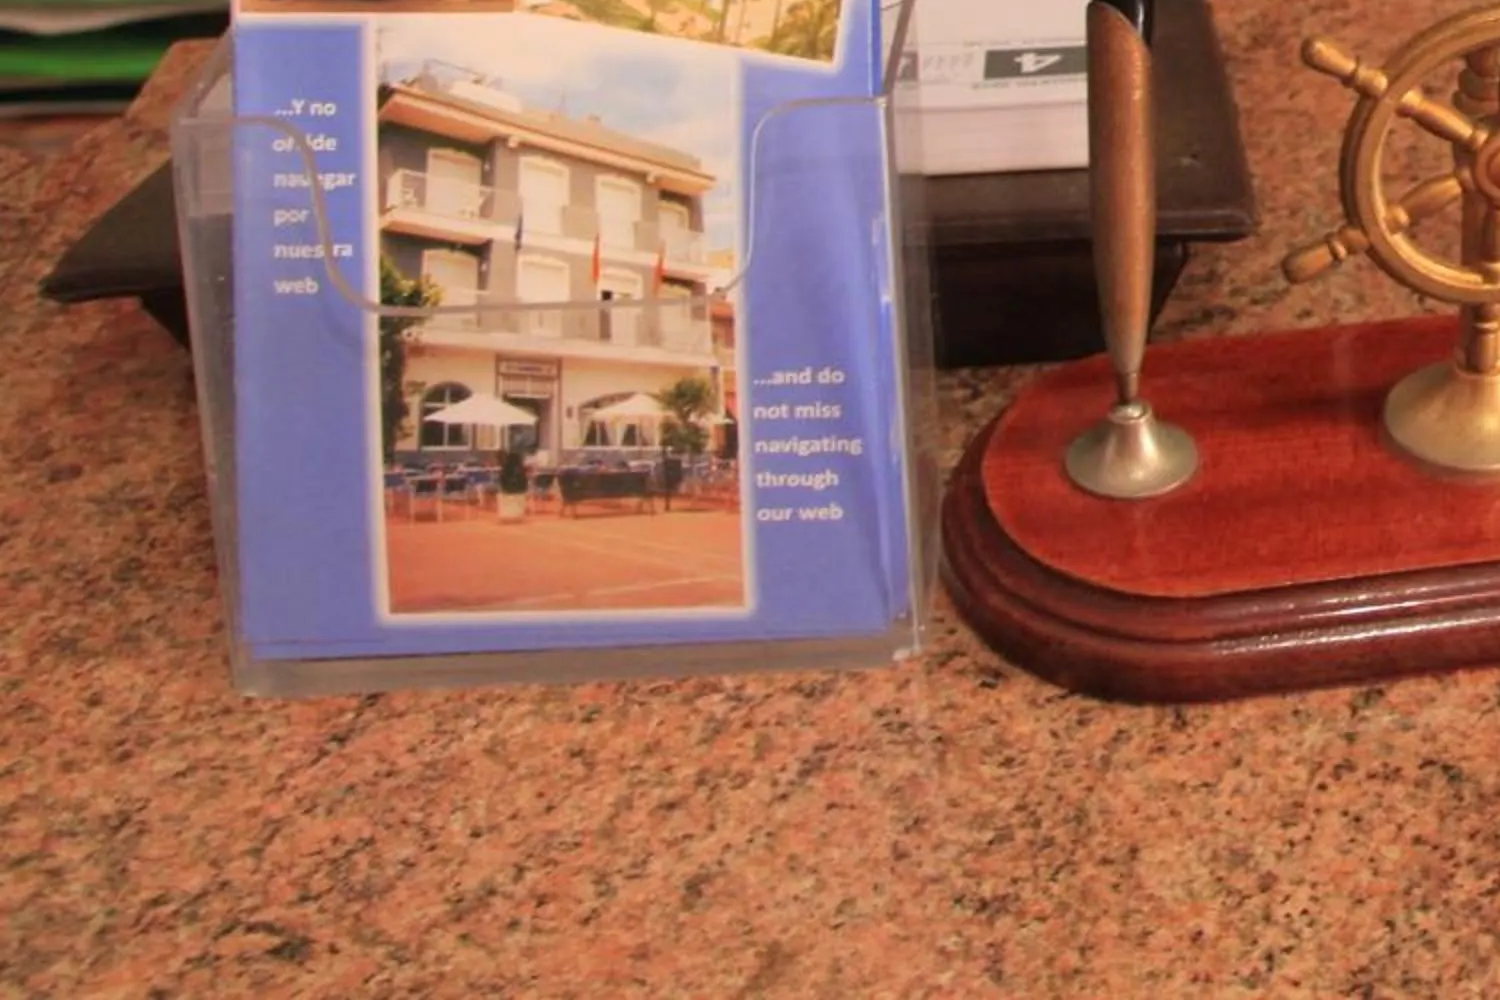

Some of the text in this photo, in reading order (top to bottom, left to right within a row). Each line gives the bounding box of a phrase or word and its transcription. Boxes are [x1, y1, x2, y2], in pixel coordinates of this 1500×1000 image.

[309, 102, 337, 116] no
[274, 208, 310, 227] por
[274, 243, 353, 258] nuesra
[274, 276, 319, 294] web
[753, 365, 845, 385] ...and do
[753, 401, 842, 420] not miss
[755, 435, 863, 457] navigating
[756, 468, 839, 491] through
[757, 502, 844, 522] our web
